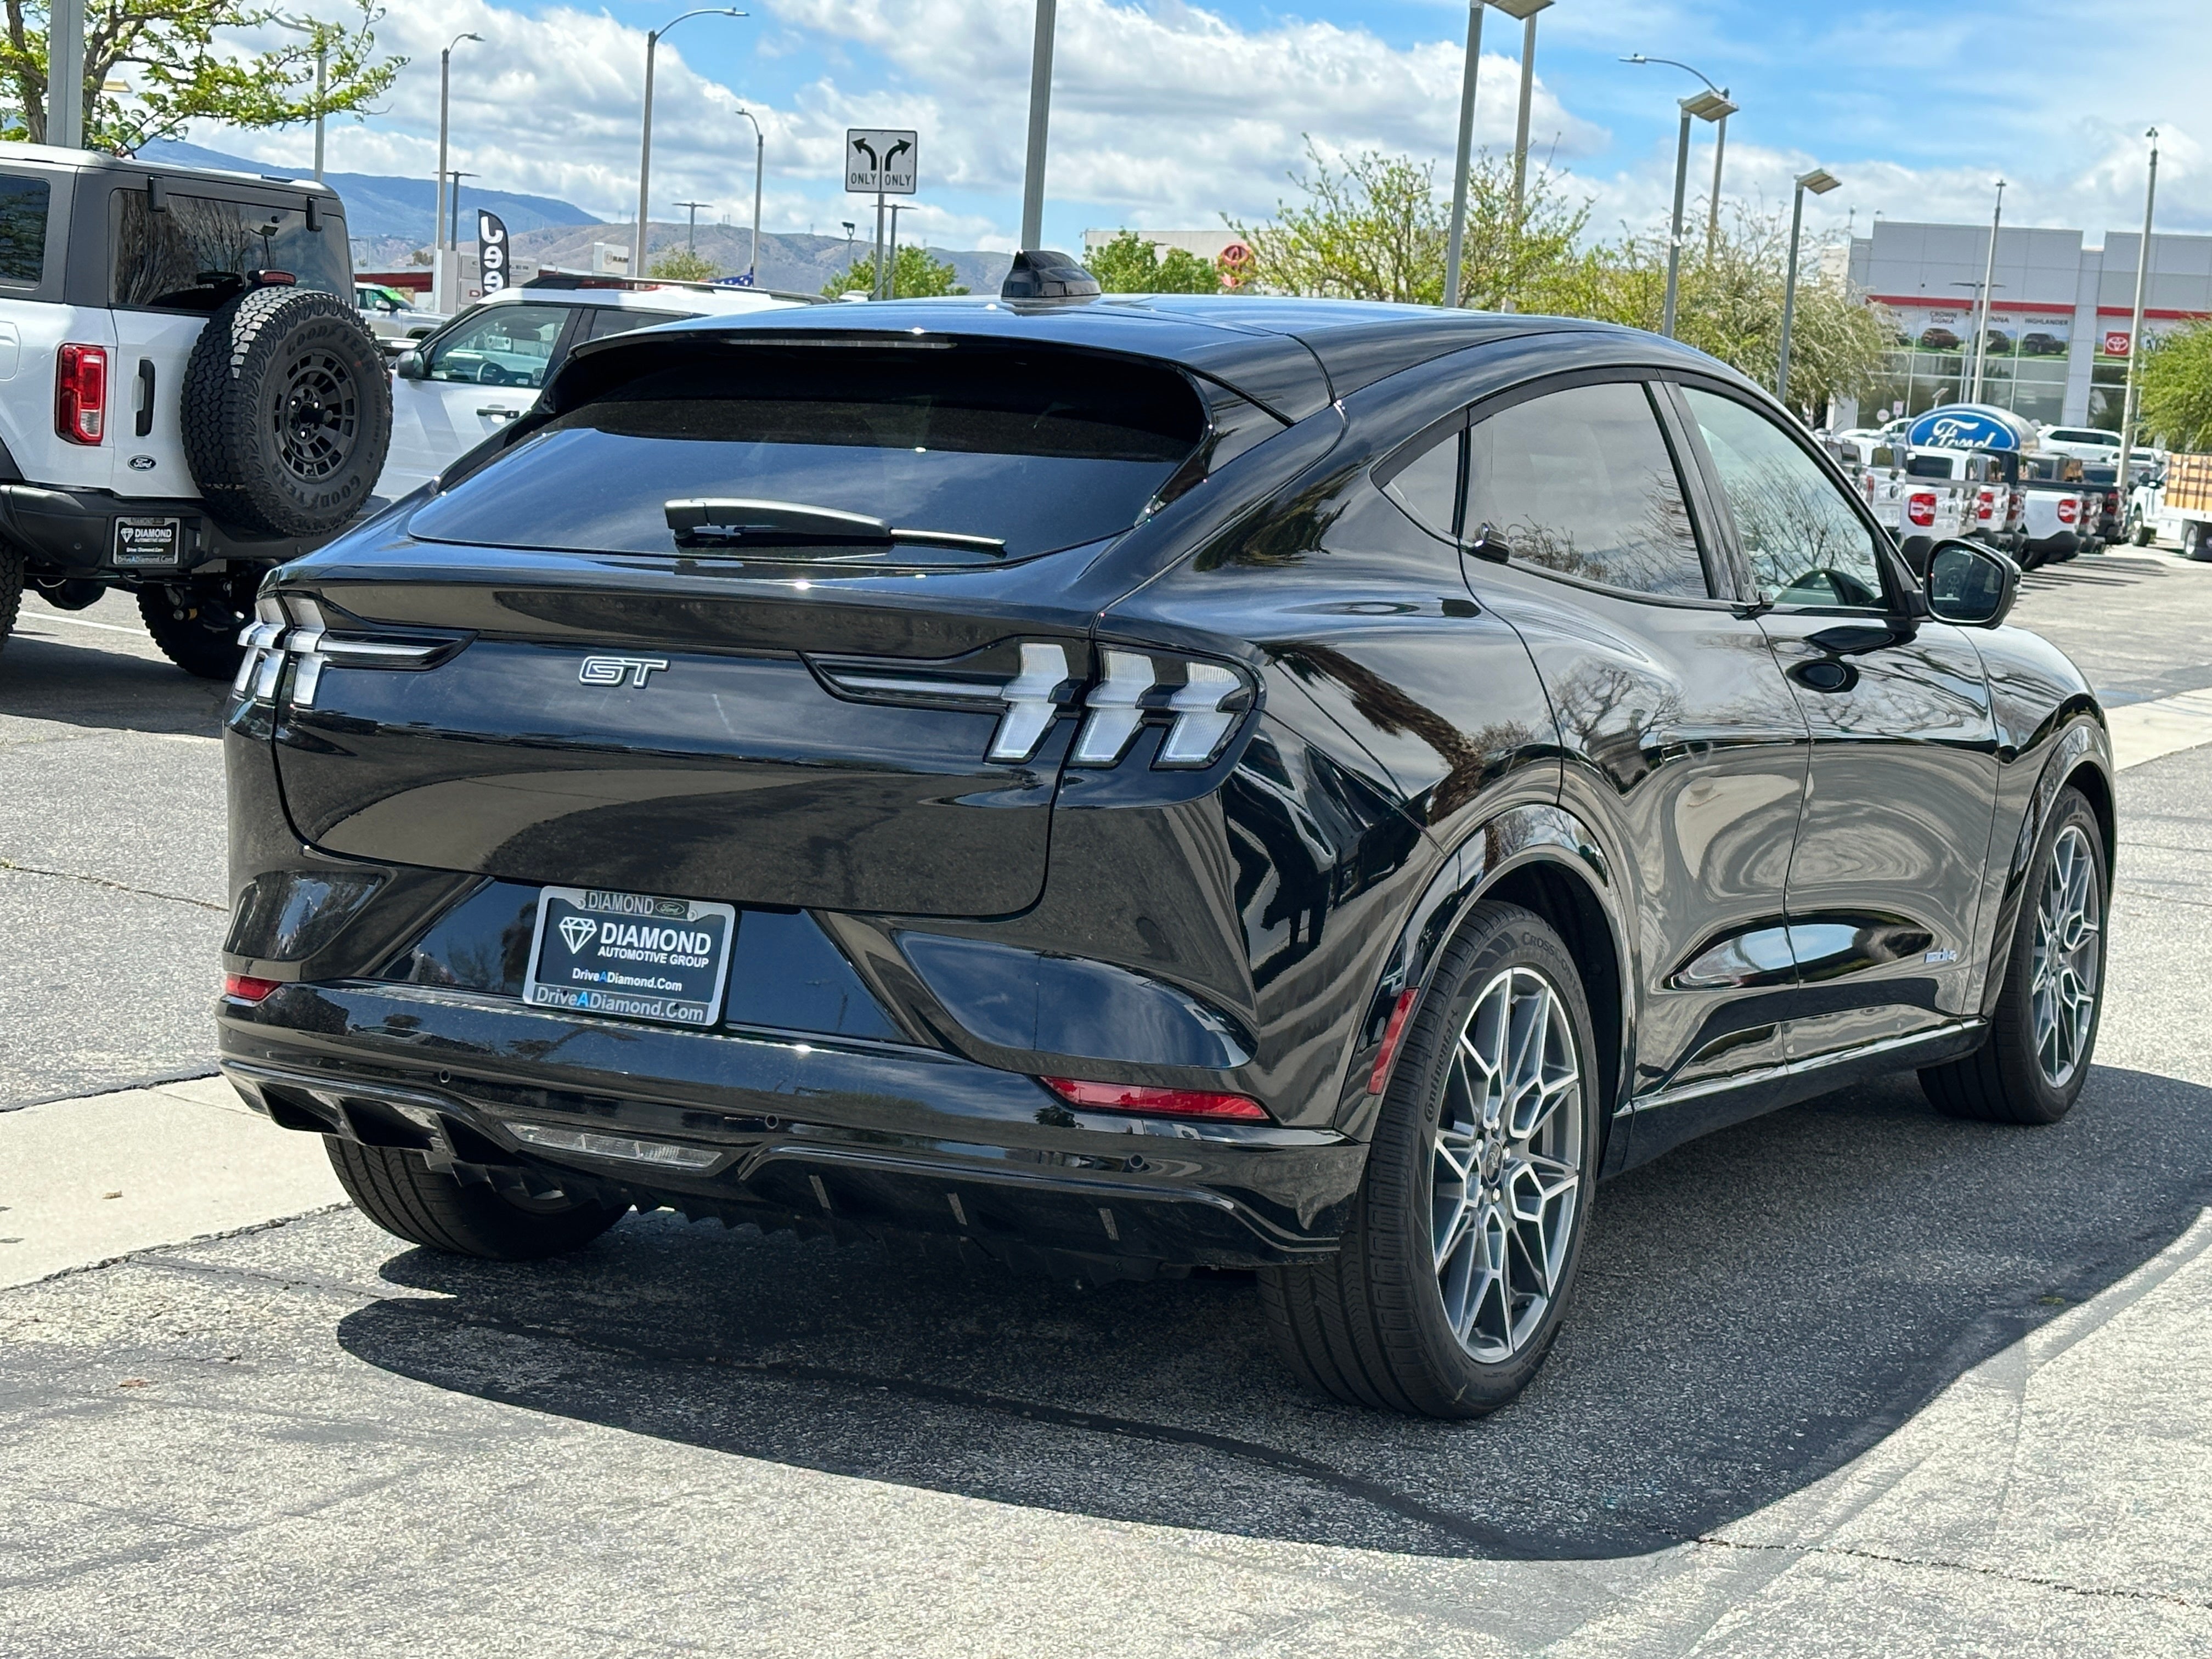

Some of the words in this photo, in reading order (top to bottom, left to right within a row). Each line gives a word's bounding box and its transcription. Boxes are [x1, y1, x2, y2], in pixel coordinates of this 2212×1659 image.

[850, 172, 877, 185] ONLY
[884, 173, 912, 187] ONLY
[2024, 317, 2068, 326] HIGHLANDER
[134, 528, 172, 538] DIAMOND
[579, 656, 669, 687] GT
[589, 892, 654, 915] DIAMOND
[600, 922, 712, 955] DIAMOND
[597, 946, 668, 964] AUTOMOTIVE
[669, 954, 709, 968] GROUP
[572, 967, 682, 992] DriveADiamond.Com
[535, 986, 704, 1022] DriveADiamond.Com
